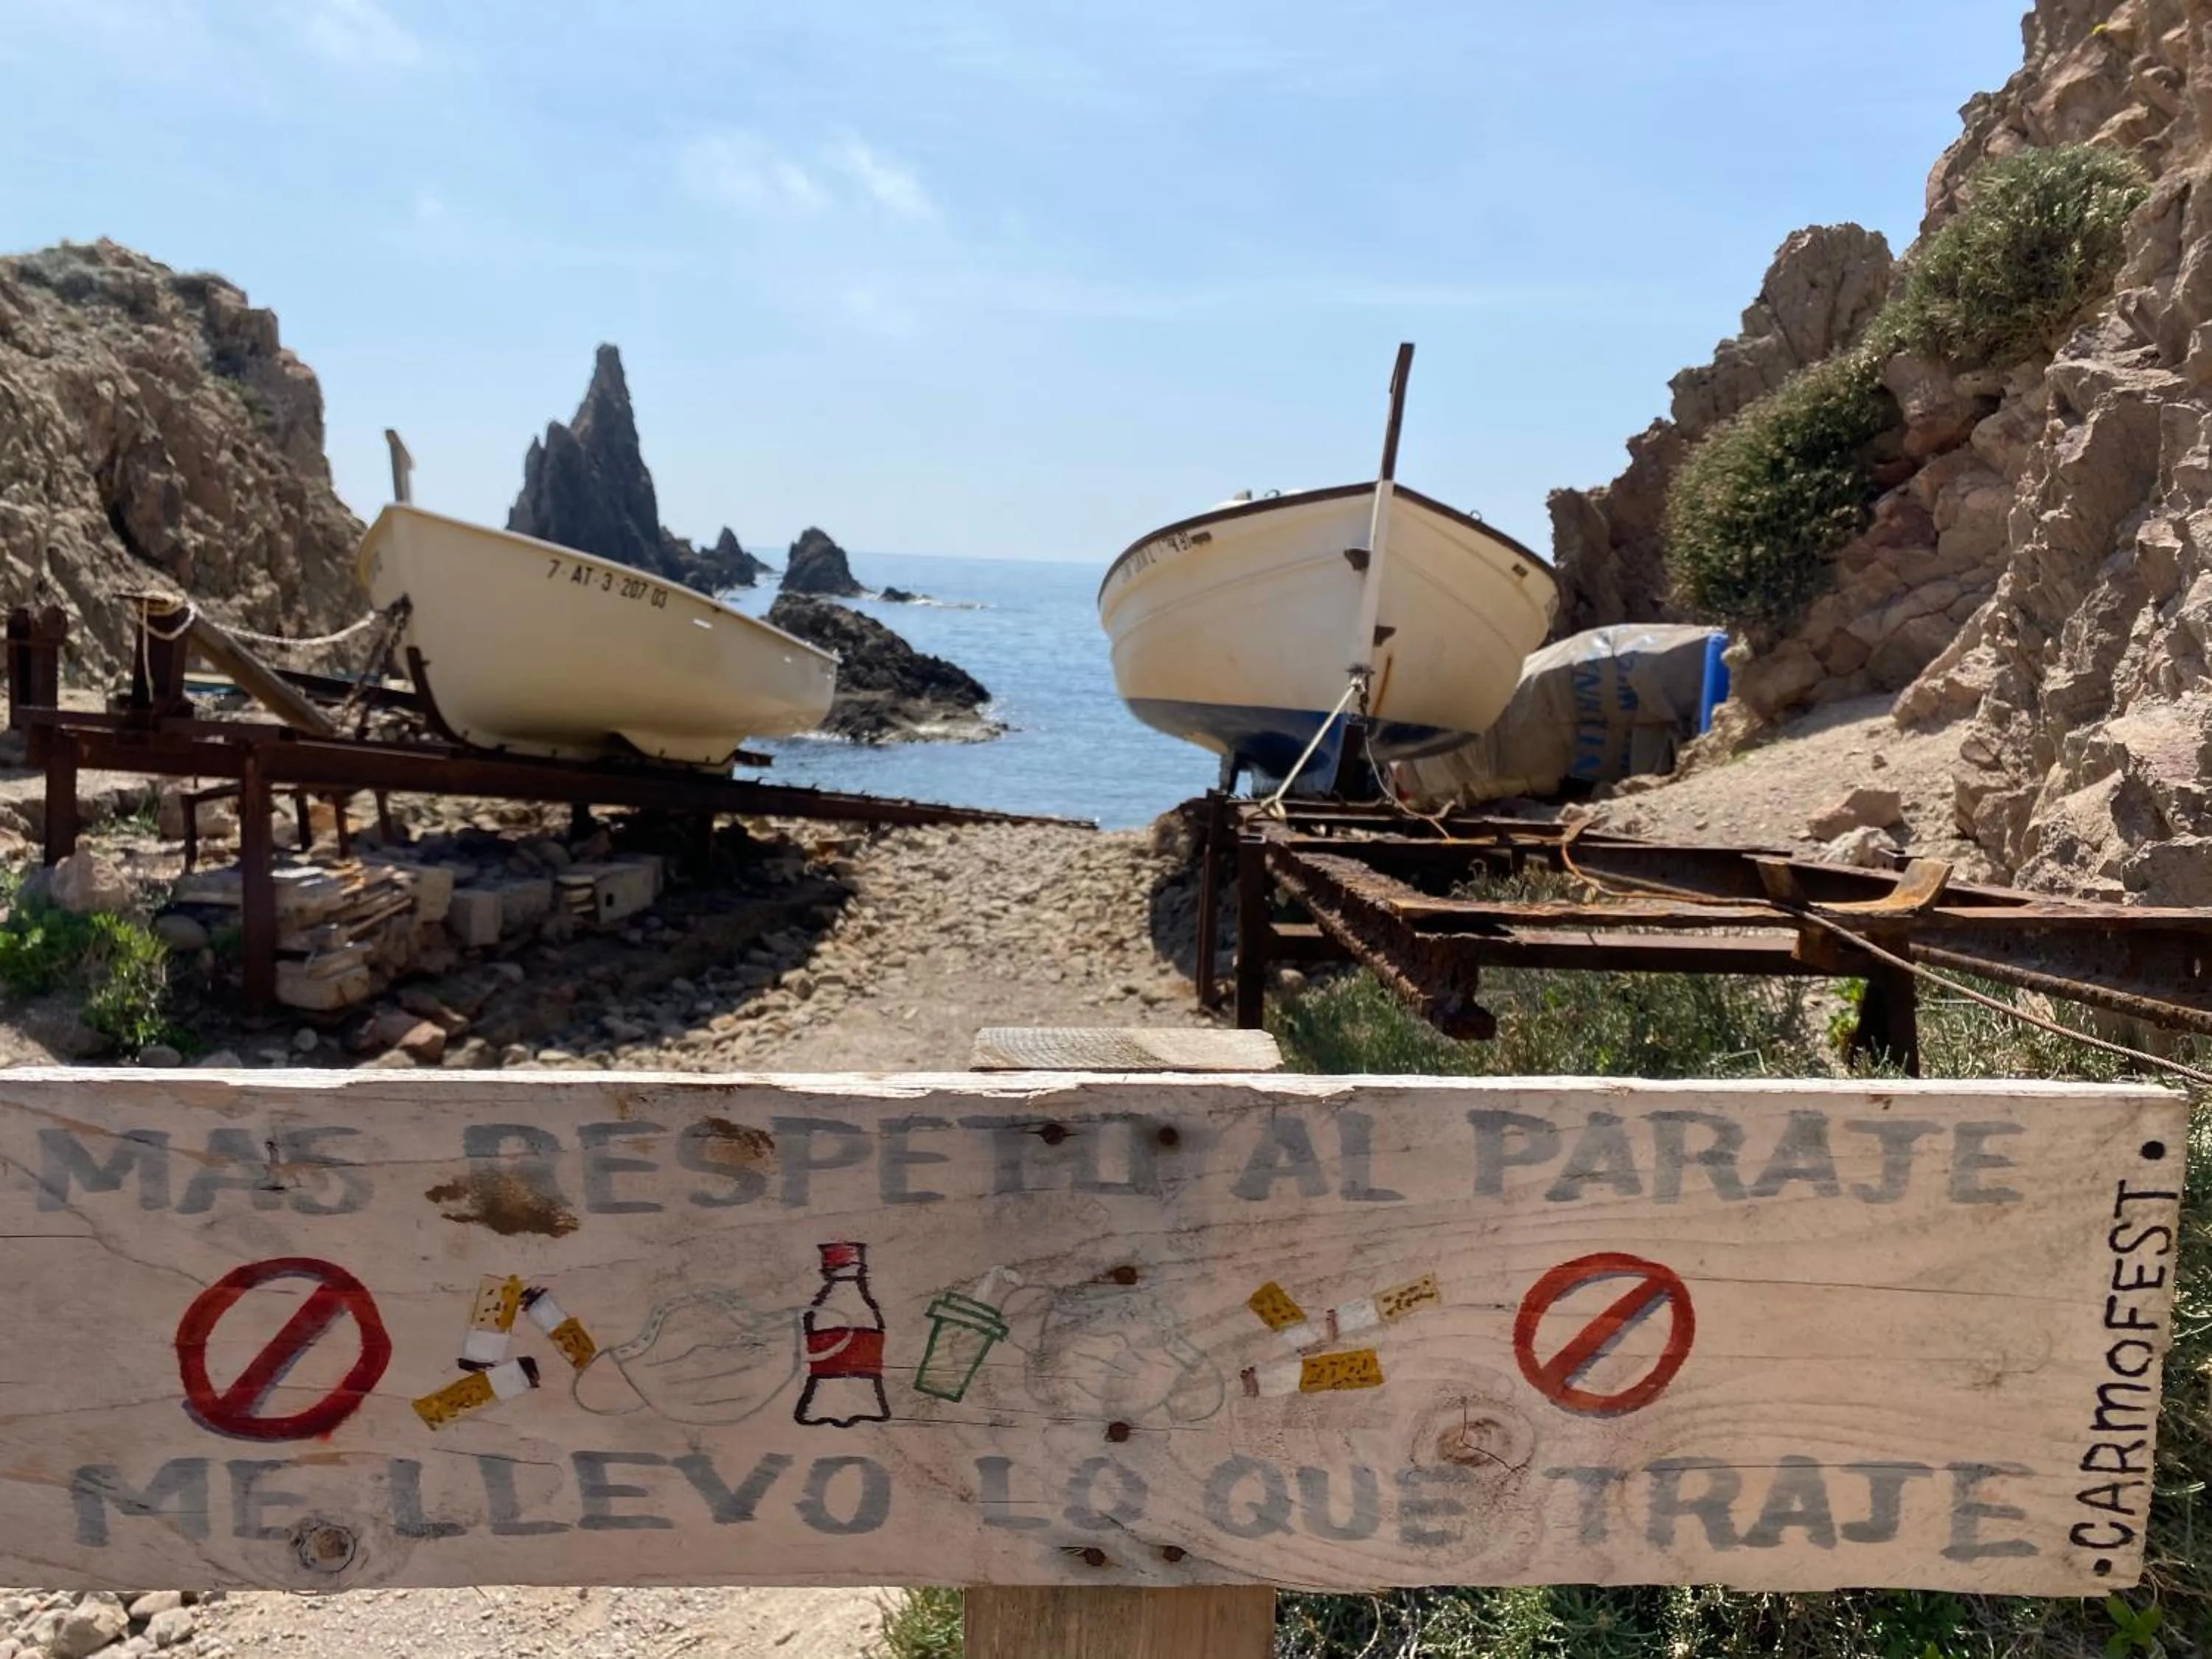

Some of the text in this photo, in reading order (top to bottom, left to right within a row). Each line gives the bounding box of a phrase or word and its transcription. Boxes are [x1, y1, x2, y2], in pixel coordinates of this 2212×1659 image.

[35, 1126, 375, 1214] MAS
[1230, 1109, 1406, 1202] AL
[1467, 1109, 2025, 1204] PARAJE
[72, 1452, 2039, 1563] ME LLEVO LO QUE TRAJE
